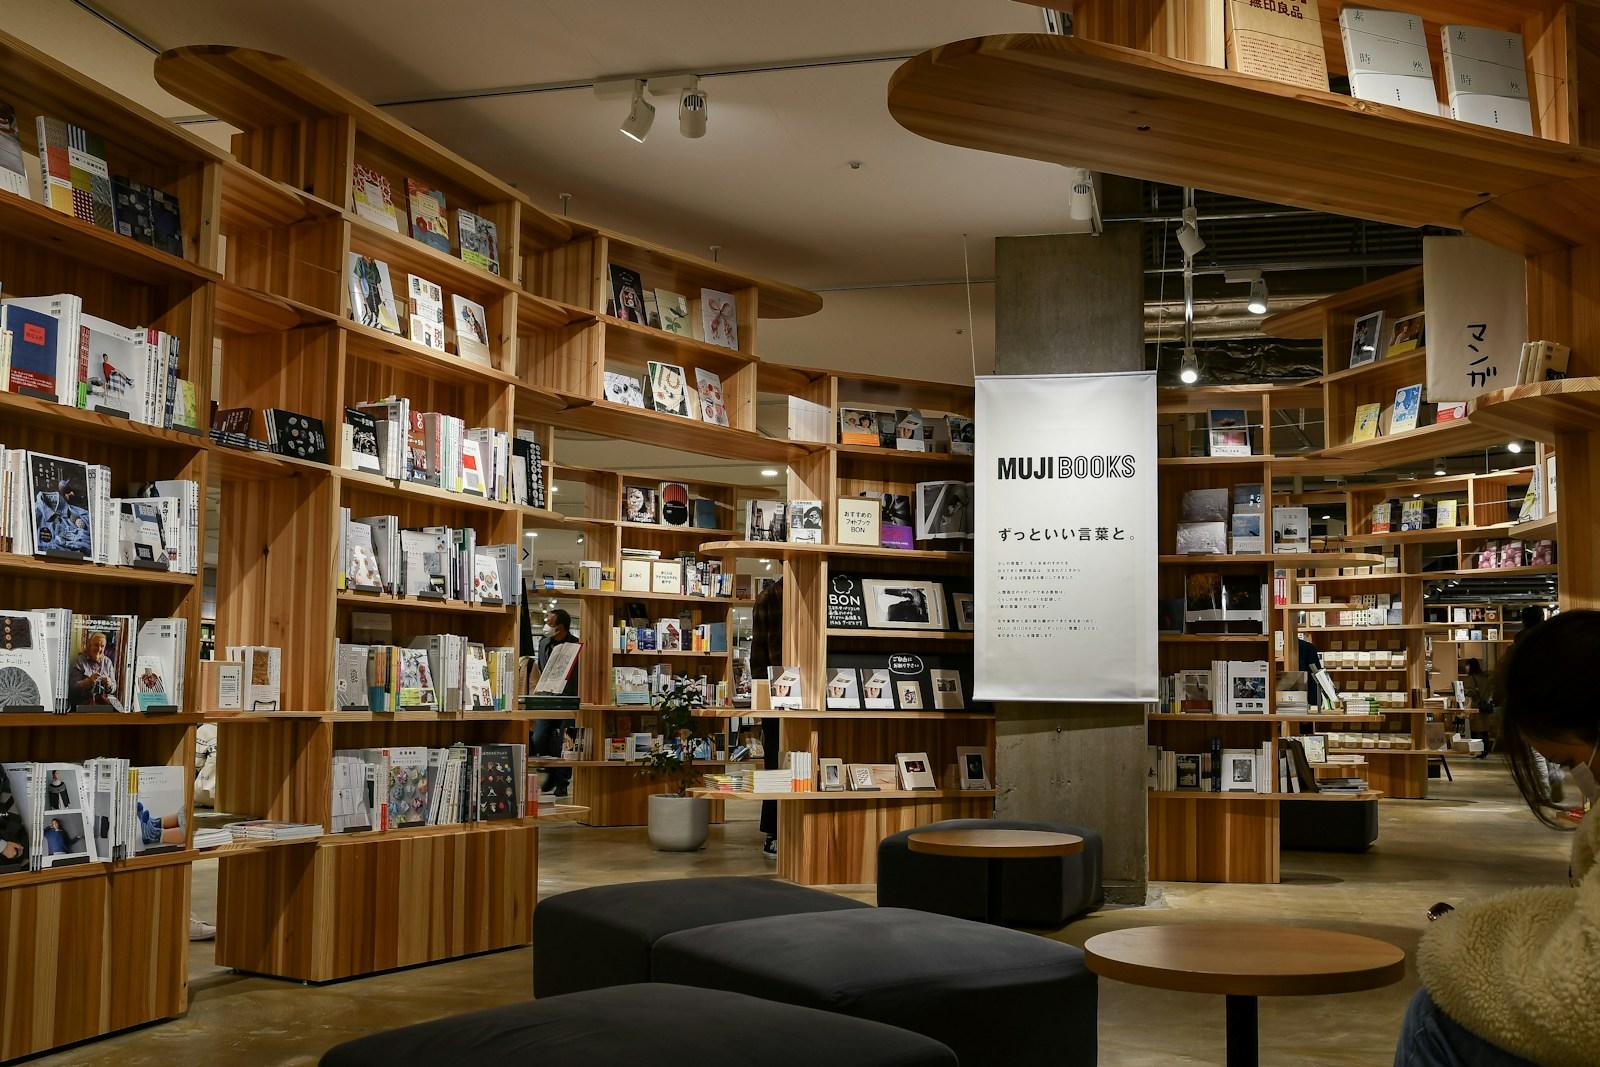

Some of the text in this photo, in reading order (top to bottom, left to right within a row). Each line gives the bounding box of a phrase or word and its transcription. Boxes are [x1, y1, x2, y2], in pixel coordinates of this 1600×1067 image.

[1466, 324, 1497, 387] マンガ
[997, 455, 1136, 480] MUJI BOOKS
[844, 511, 872, 519] おすすめの
[850, 525, 866, 534] BON
[998, 527, 1135, 542] ずっといい言葉と。
[829, 594, 860, 606] BON
